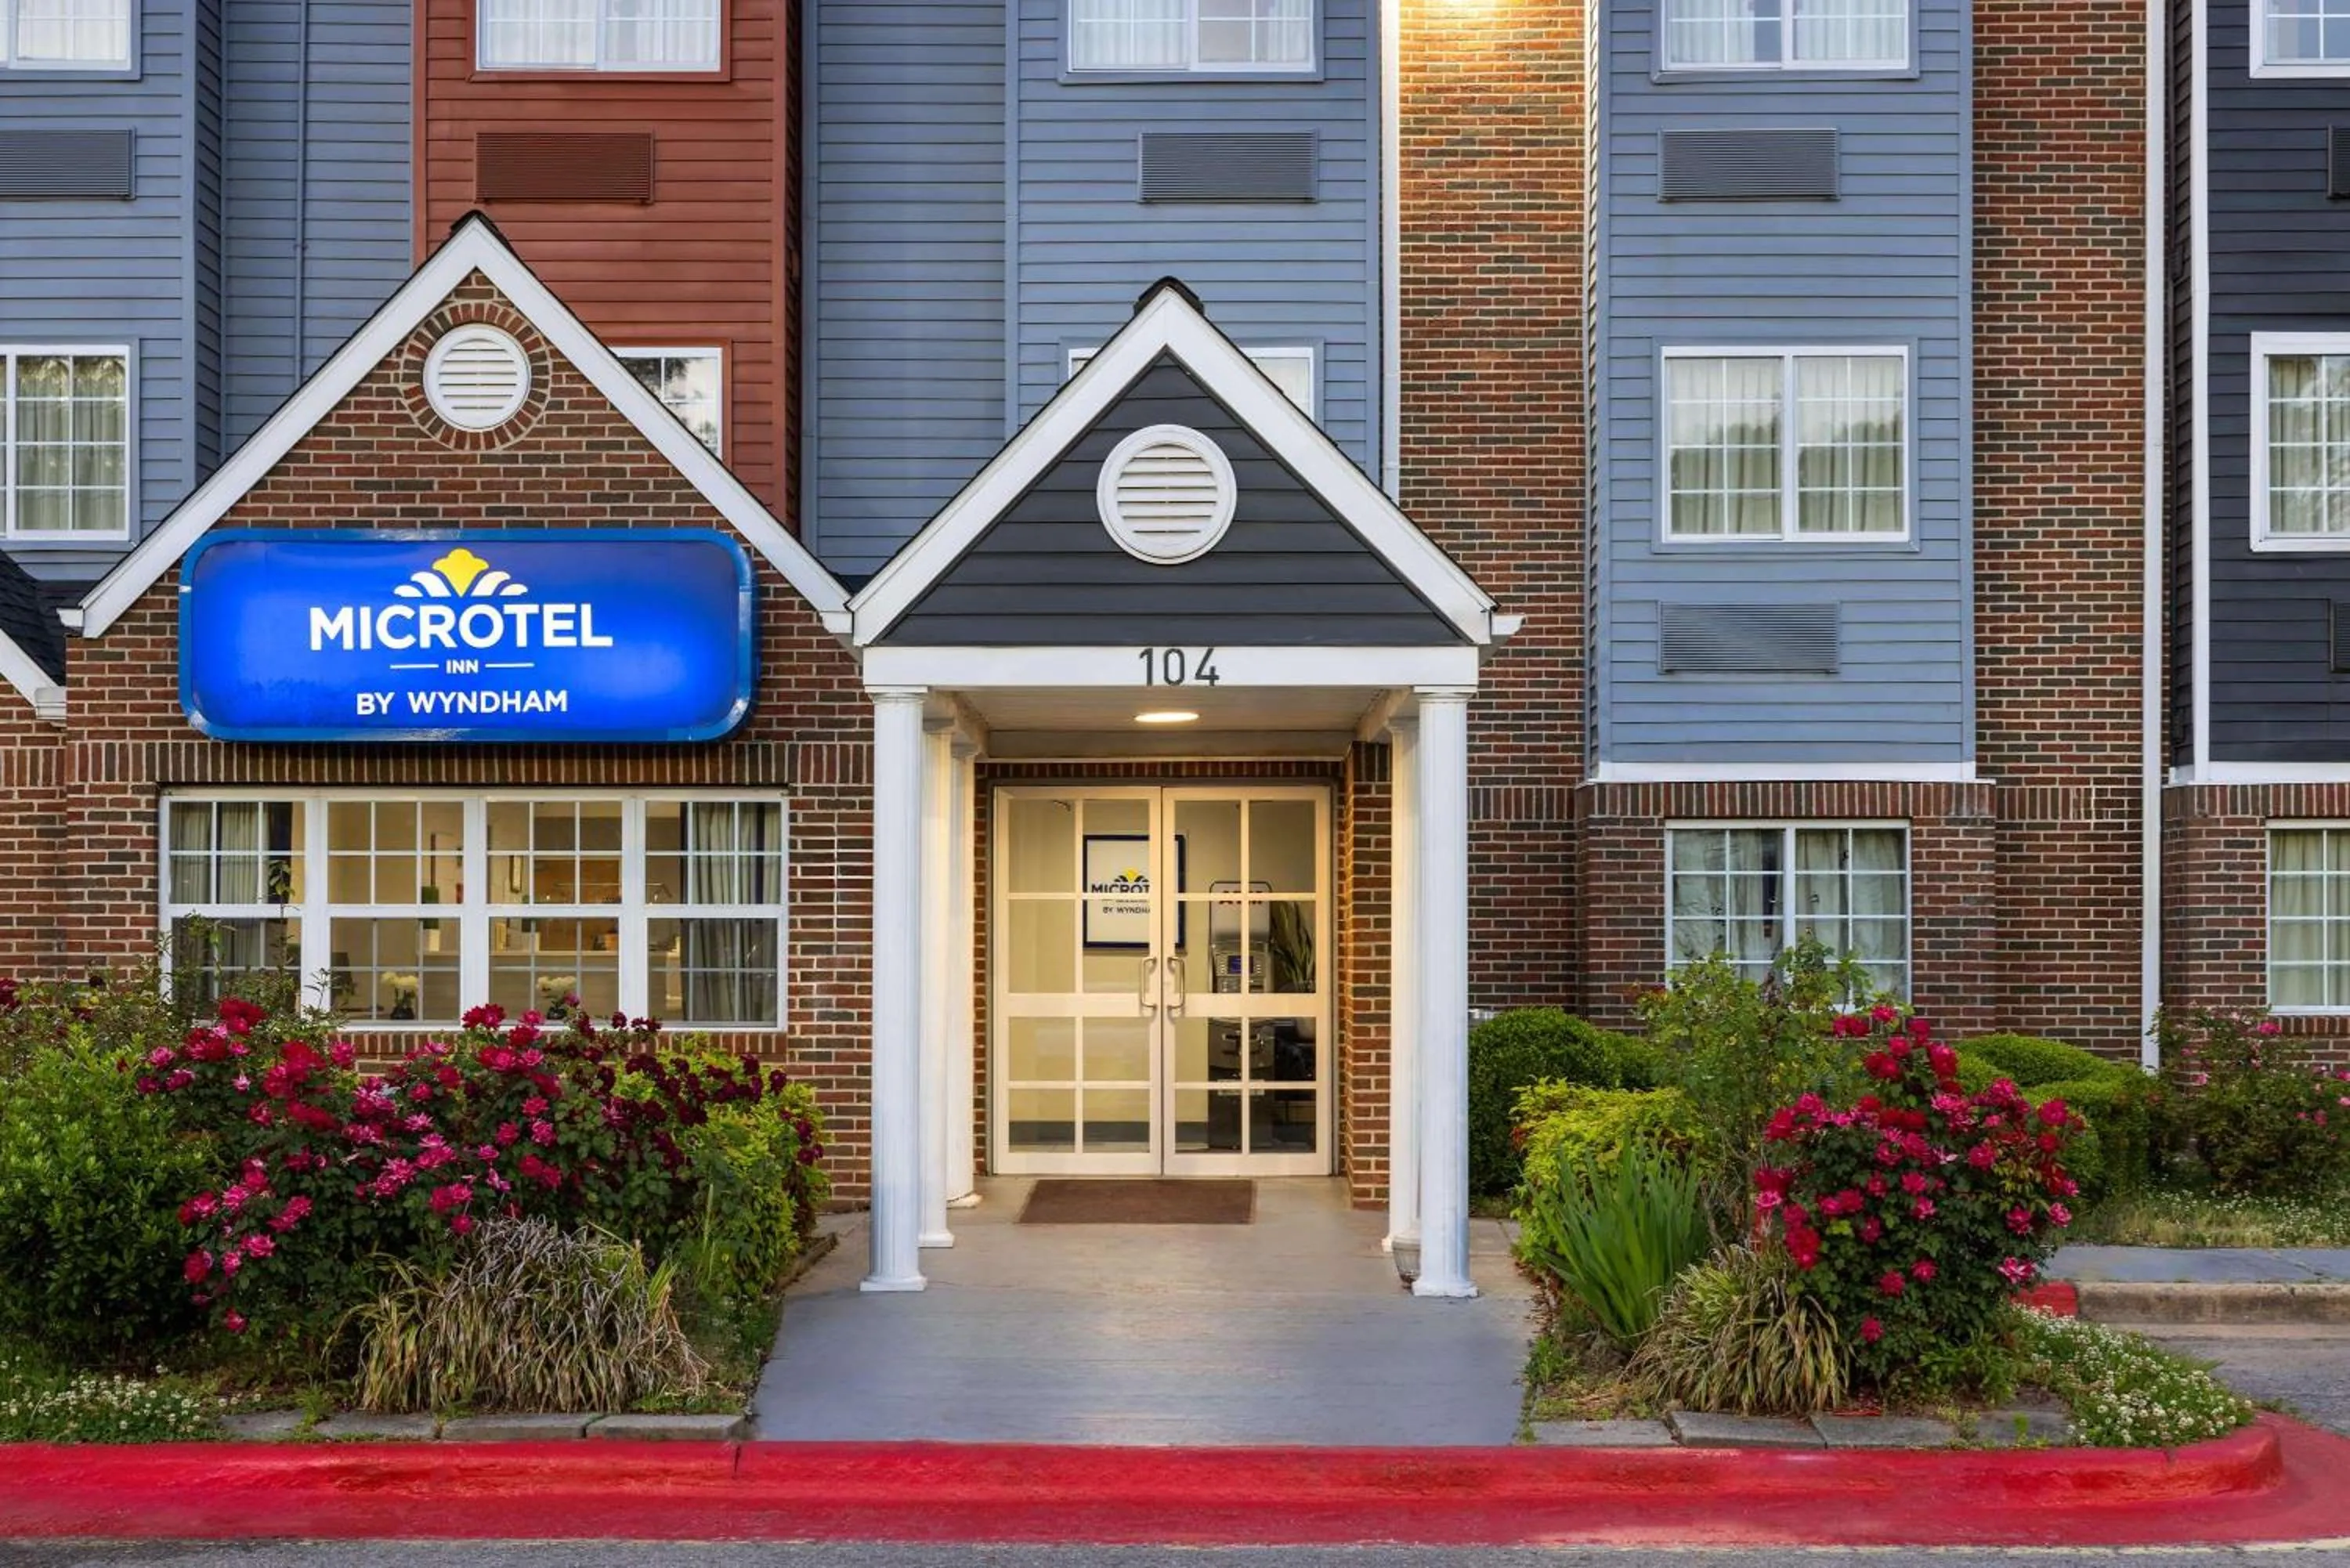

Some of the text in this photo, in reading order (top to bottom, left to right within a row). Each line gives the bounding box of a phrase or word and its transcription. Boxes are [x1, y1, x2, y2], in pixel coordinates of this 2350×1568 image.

[309, 603, 613, 651] MICROTEL
[446, 659, 479, 674] INN
[1139, 647, 1220, 687] 104
[356, 689, 568, 715] BY WYNDHAM
[1091, 883, 1150, 893] MICROT
